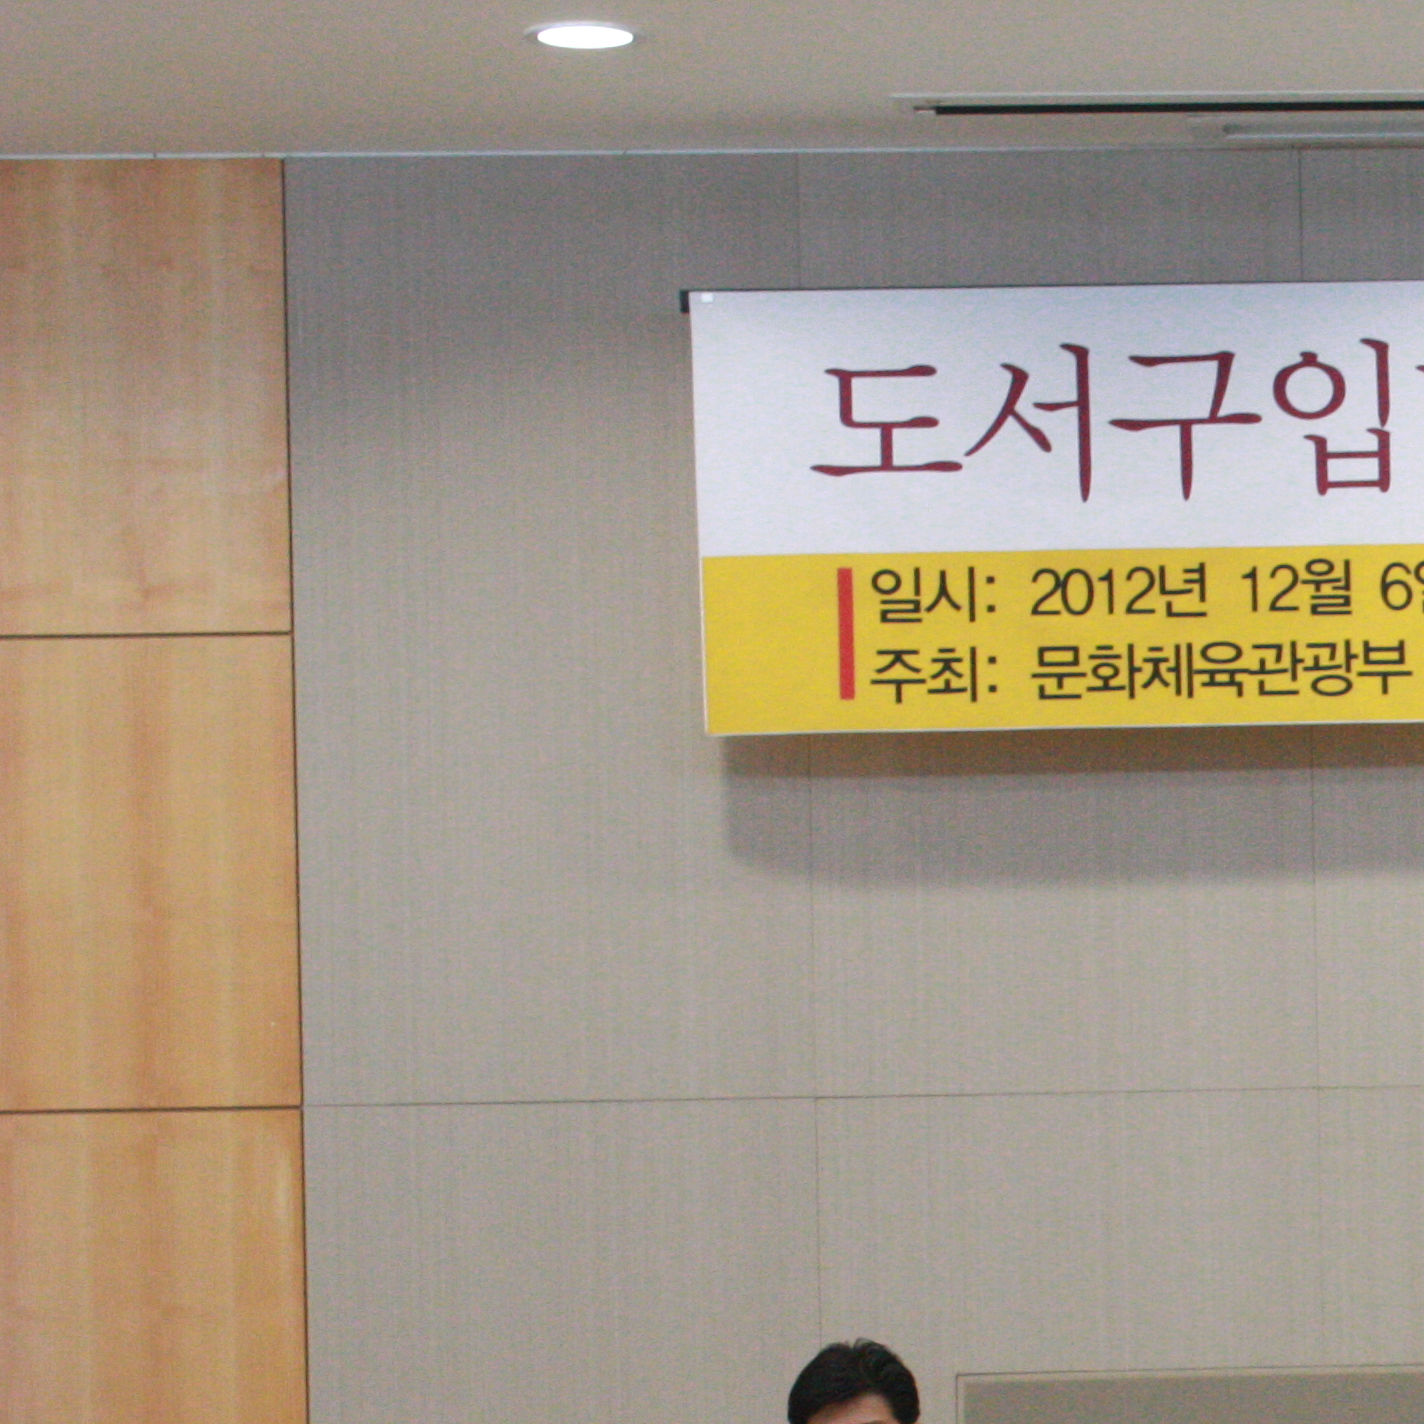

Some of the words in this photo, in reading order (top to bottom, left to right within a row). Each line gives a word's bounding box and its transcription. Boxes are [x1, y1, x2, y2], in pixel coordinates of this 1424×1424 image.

[871, 566, 998, 625] 일시:
[1030, 562, 1209, 620] 2012년
[1241, 558, 1354, 618] 12월
[870, 646, 999, 706] 주최:
[1031, 639, 1415, 703] 문화체육관광부
